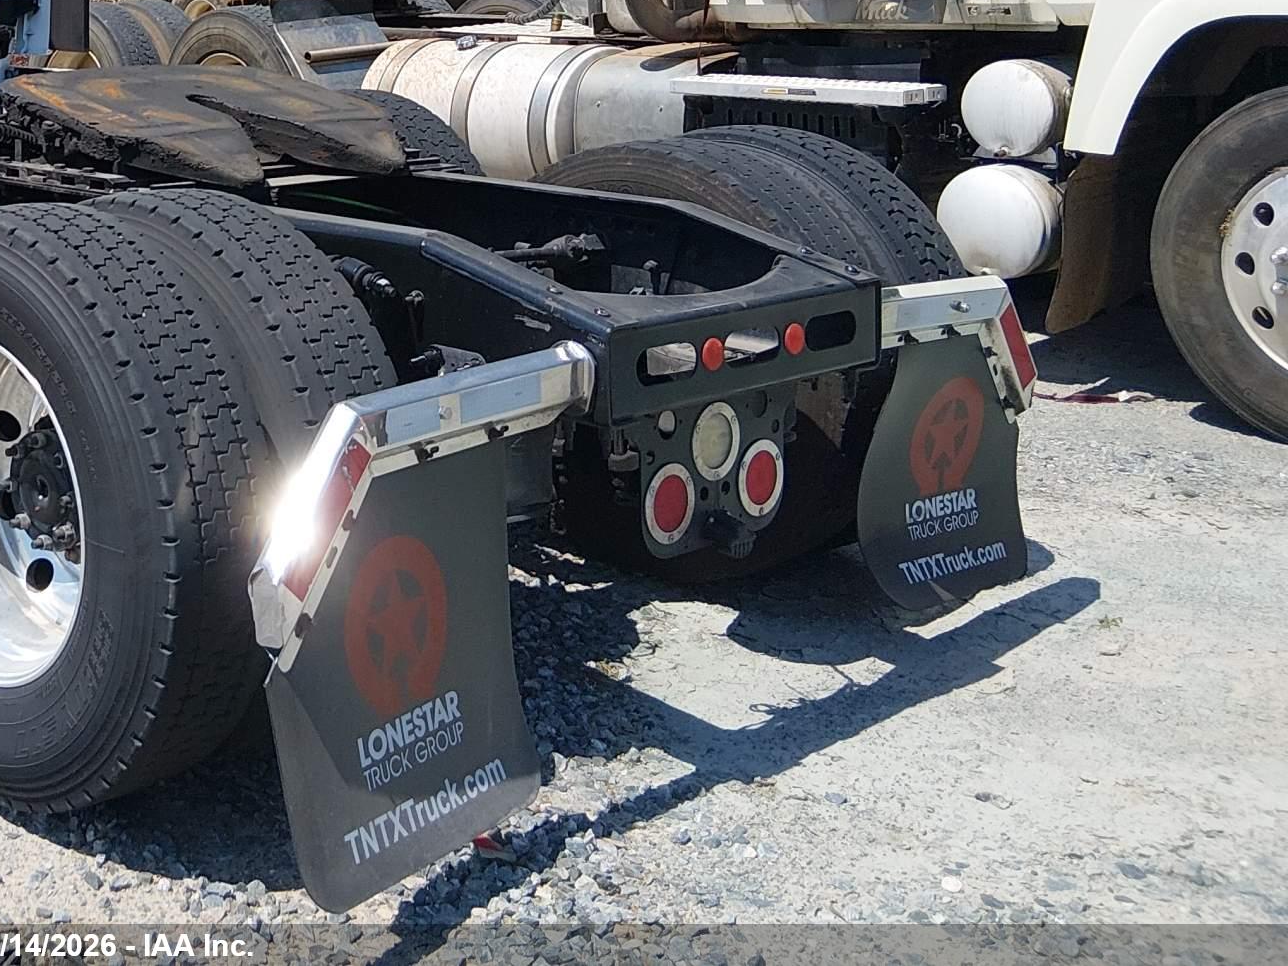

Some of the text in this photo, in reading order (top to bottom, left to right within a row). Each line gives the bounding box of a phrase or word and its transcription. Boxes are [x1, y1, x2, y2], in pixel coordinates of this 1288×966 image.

[906, 488, 977, 524] LONESTAR
[908, 510, 979, 541] TRUCK GROUP
[898, 541, 1006, 584] TNTXTruck.com
[357, 690, 461, 768] LONESTAR
[362, 721, 465, 792] TRUCK GROUP
[344, 757, 507, 865] TNTXTruck.com
